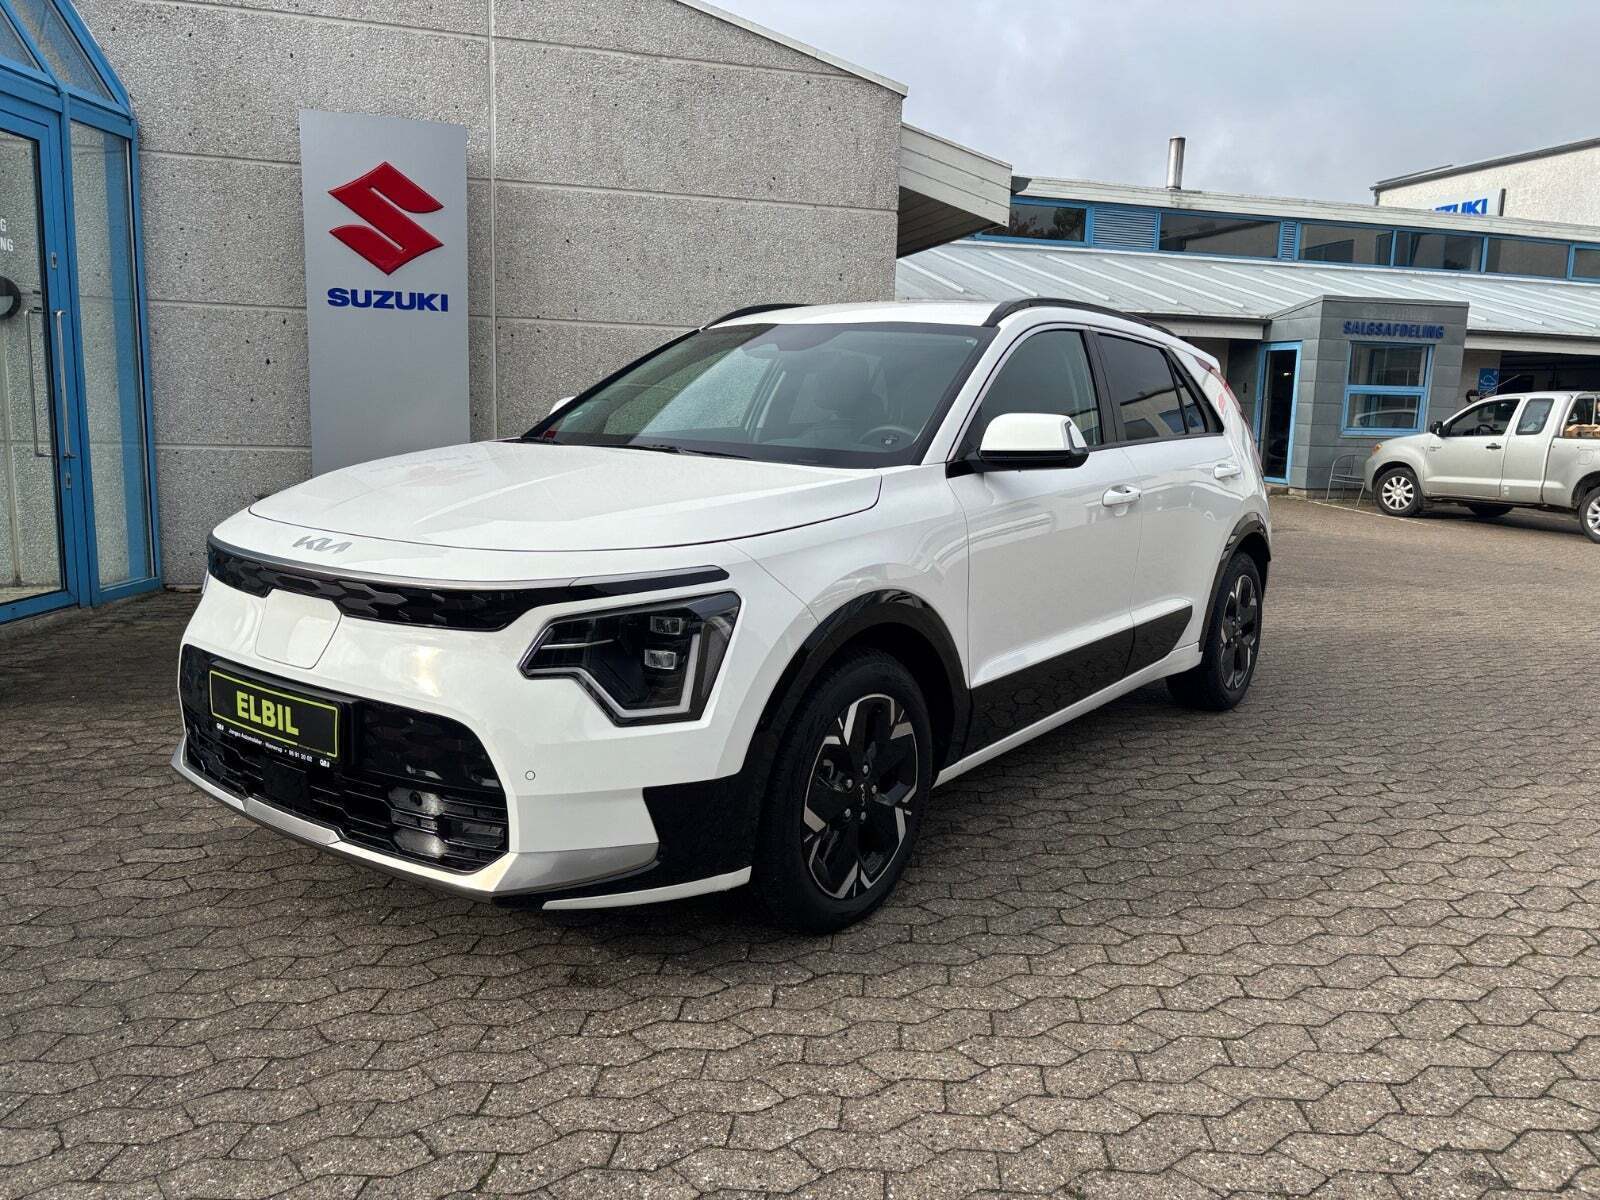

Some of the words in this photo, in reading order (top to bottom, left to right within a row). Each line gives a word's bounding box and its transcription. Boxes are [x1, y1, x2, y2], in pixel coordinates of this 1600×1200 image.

[327, 287, 449, 312] SUZUKI
[1343, 320, 1445, 339] SALGSAFDELING
[236, 690, 300, 736] ELBIL
